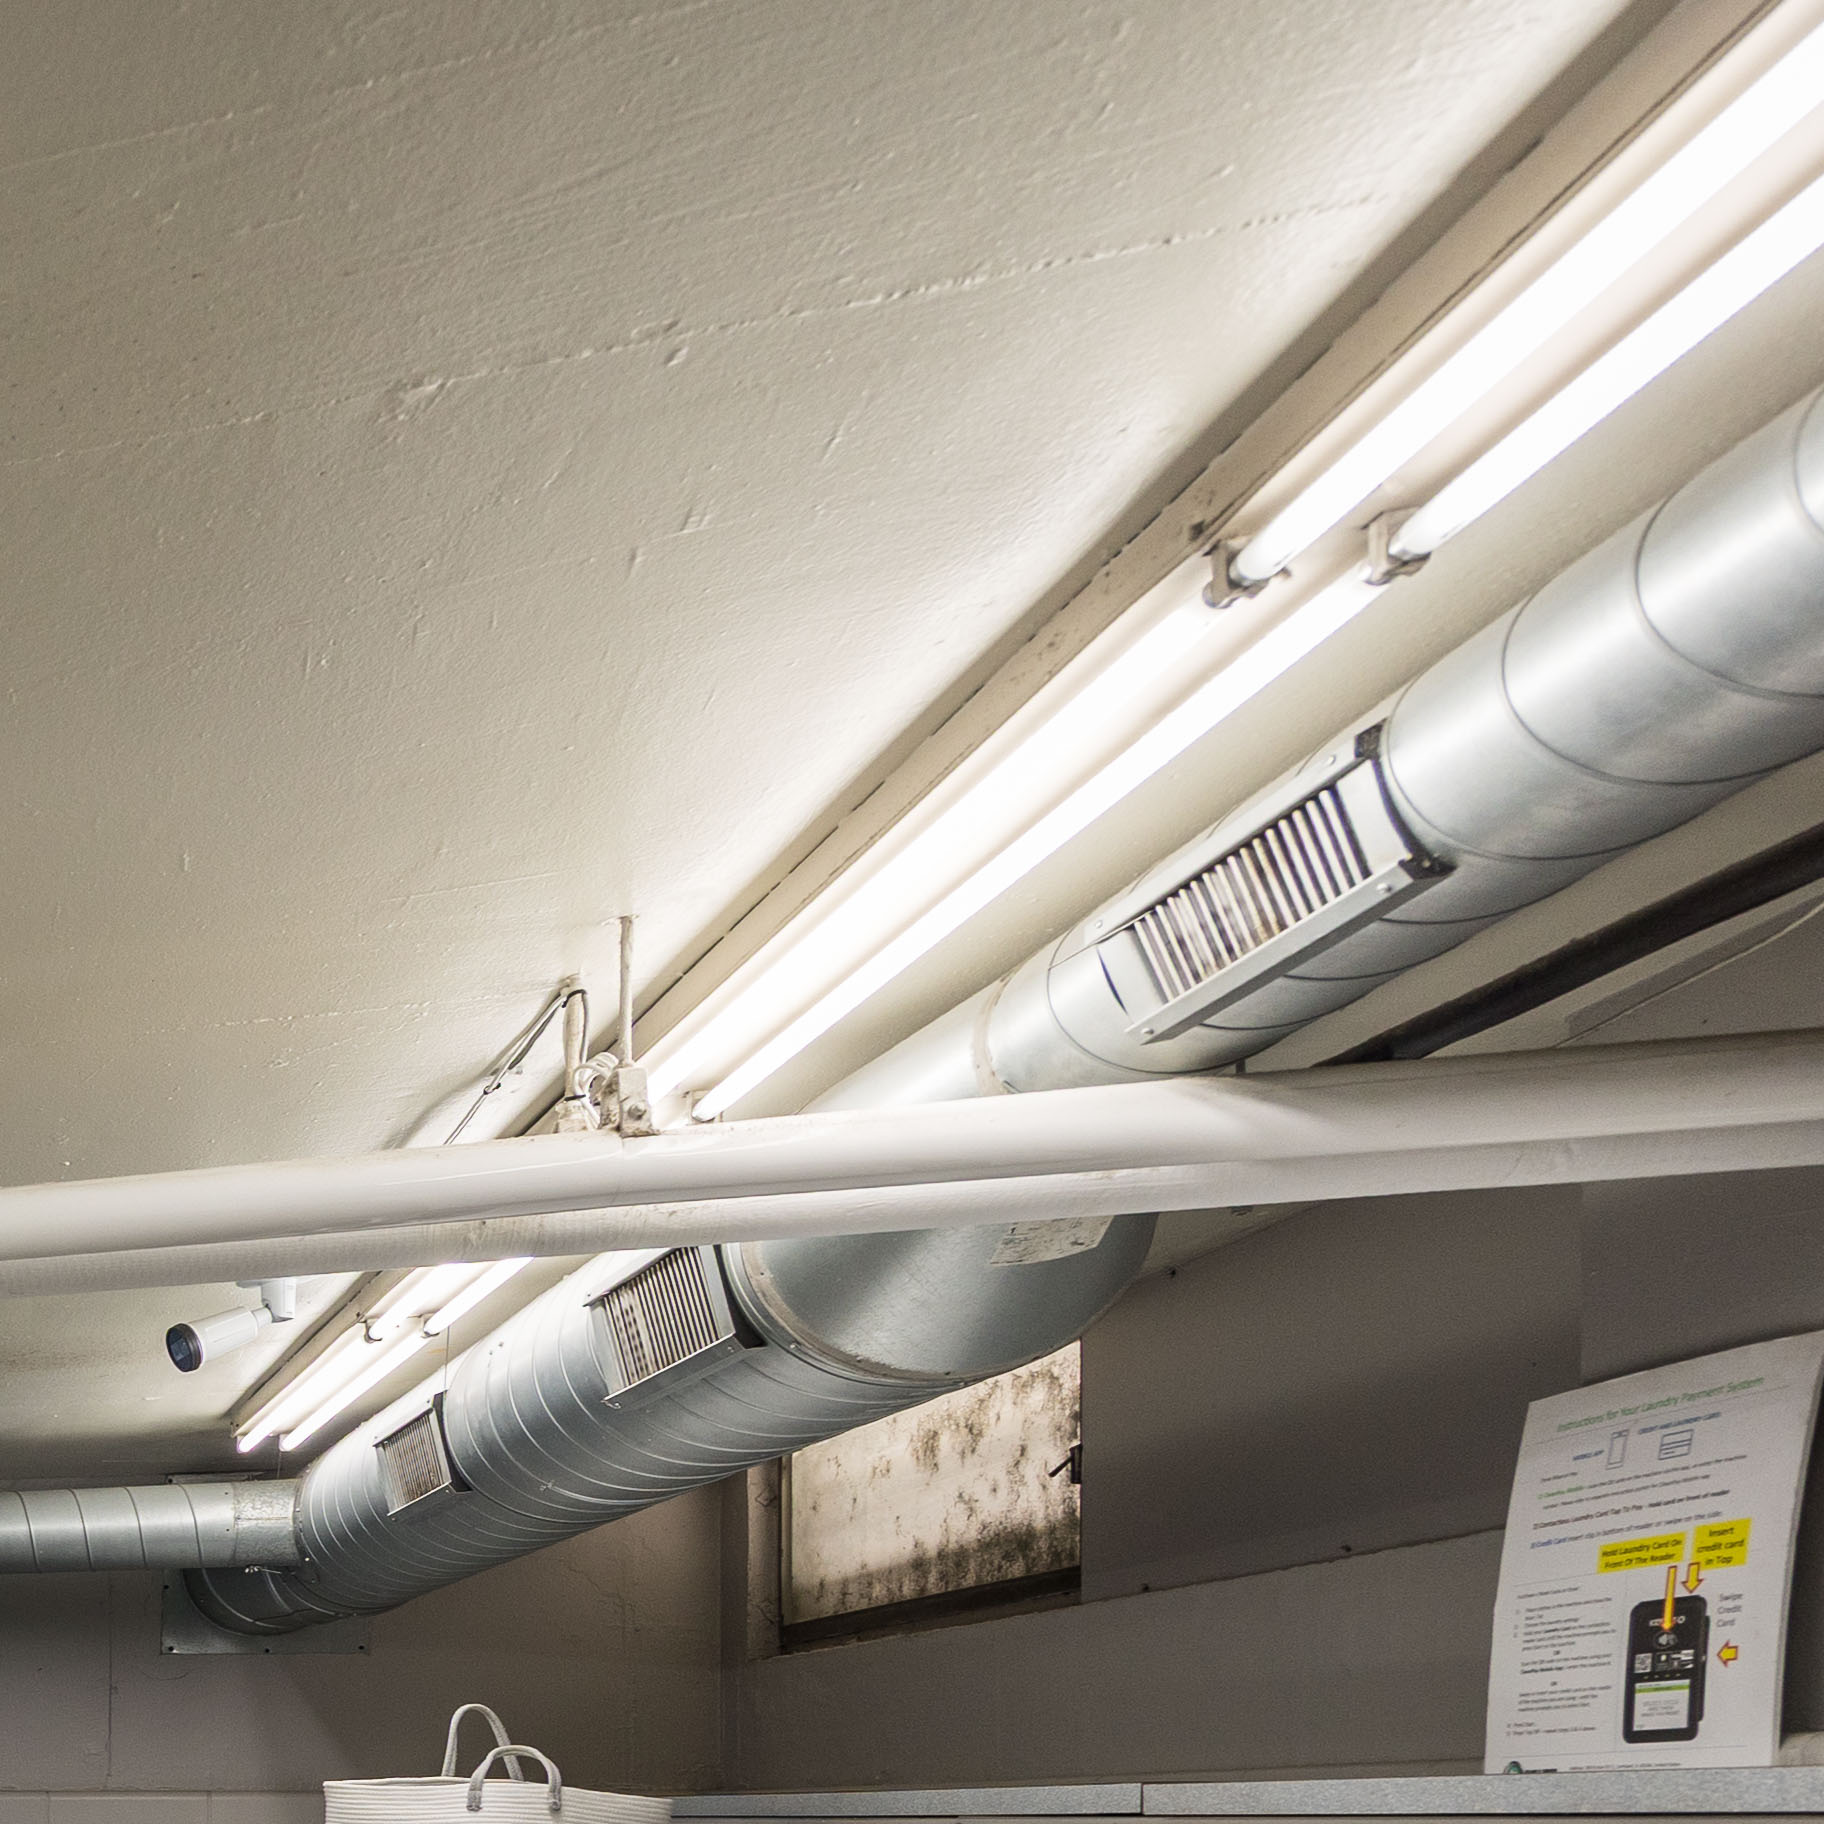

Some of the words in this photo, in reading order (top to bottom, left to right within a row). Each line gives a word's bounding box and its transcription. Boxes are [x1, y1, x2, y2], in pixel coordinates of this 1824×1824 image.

[1606, 1410, 1619, 1420] for
[1620, 1405, 1640, 1416] Your
[1642, 1397, 1679, 1412] Laundry
[1708, 1527, 1735, 1537] Insert
[1652, 1540, 1670, 1550] Card
[1724, 1539, 1745, 1549] card
